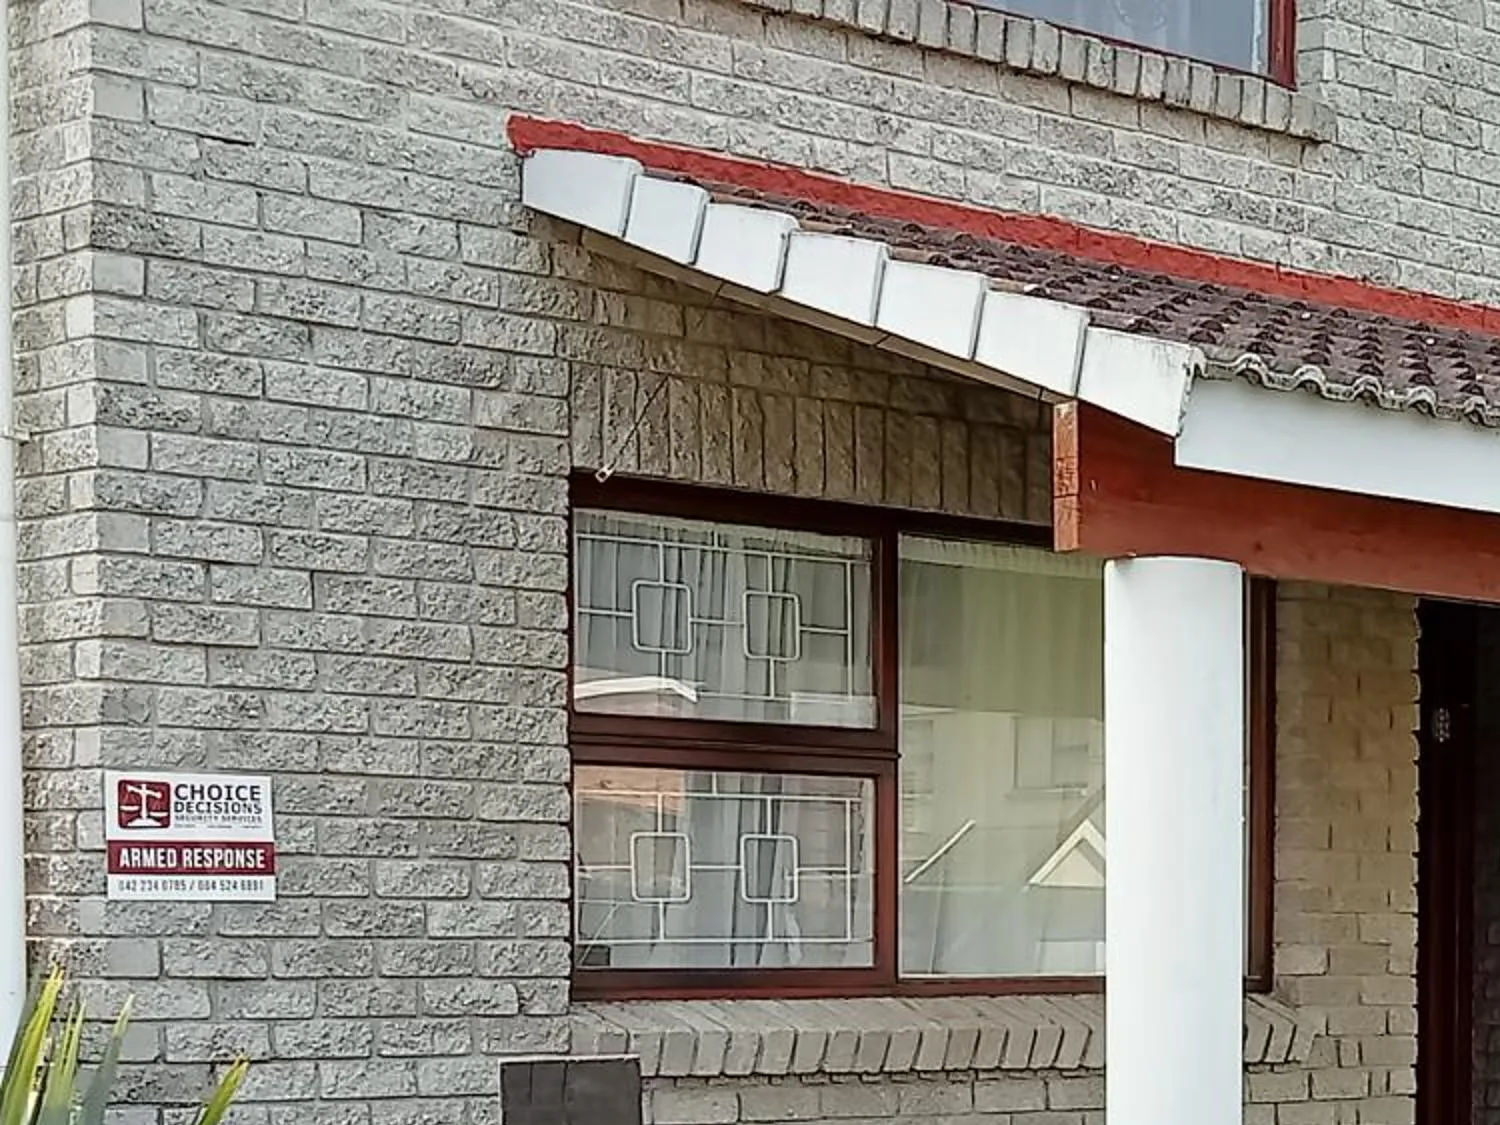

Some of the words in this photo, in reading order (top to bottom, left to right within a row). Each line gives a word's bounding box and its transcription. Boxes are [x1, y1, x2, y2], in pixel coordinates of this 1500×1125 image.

[174, 783, 261, 801] CHOICE
[174, 801, 262, 815] DECISIONS
[120, 847, 177, 868] ARMED
[182, 848, 266, 869] RESPONSE
